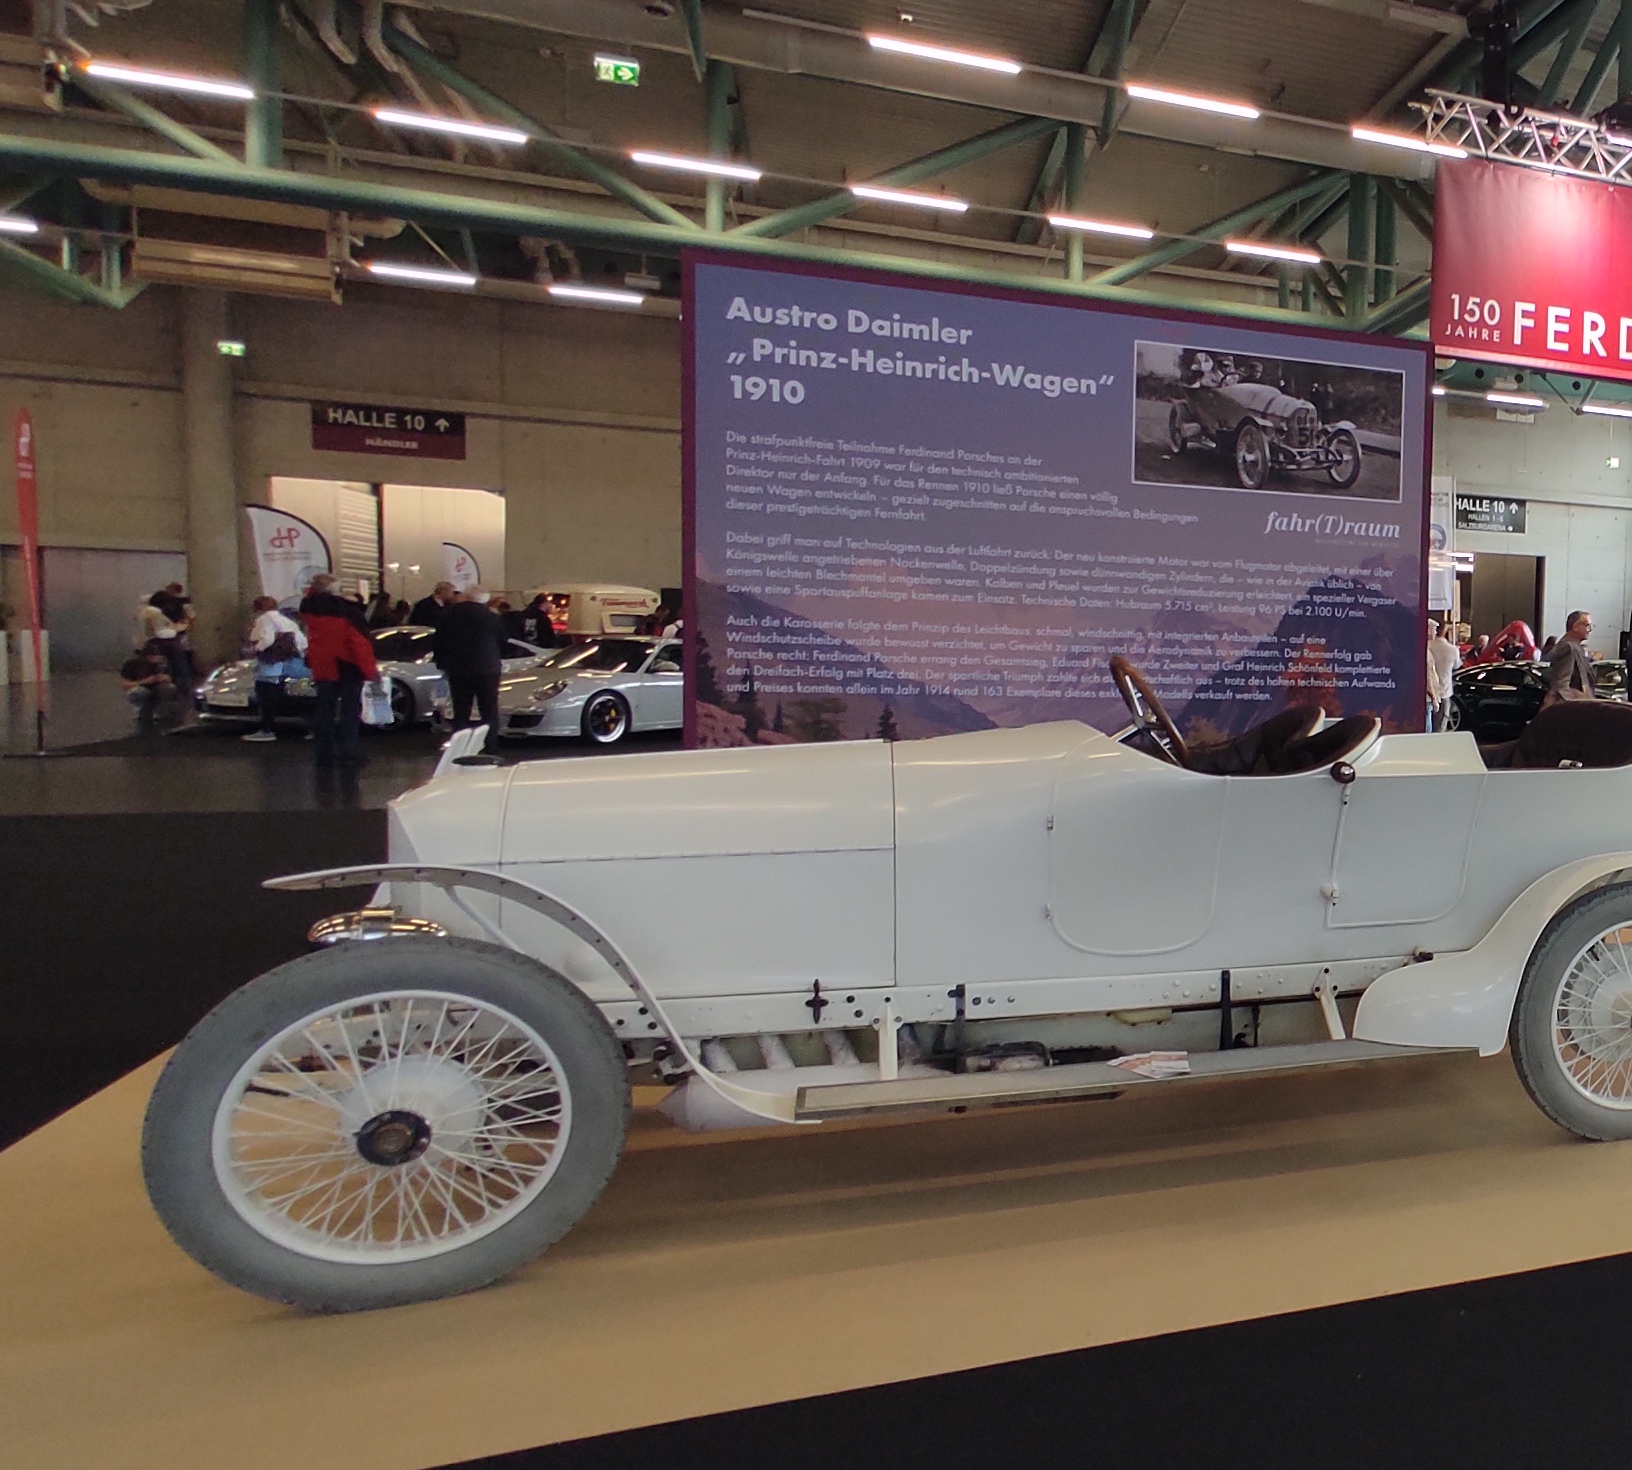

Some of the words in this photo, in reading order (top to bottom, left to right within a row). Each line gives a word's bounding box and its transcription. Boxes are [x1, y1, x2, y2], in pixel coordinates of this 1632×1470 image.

[1450, 293, 1501, 326] 150
[726, 297, 838, 331] Austro
[847, 309, 973, 345] Daimler
[1445, 324, 1501, 343] JAHRE
[730, 375, 805, 405] 1910
[328, 407, 398, 429] HALLE
[404, 415, 426, 431] 10
[726, 432, 747, 443] Die
[837, 440, 895, 454] Teilnahme
[899, 444, 954, 459] Ferdinand
[1024, 455, 1042, 466] der
[726, 448, 845, 467] Prinz-Heinrich-Fahrt
[850, 457, 881, 469] 1909
[909, 461, 924, 472] für
[927, 463, 948, 474] den
[726, 465, 774, 478] Direktor
[777, 471, 796, 480] nur
[800, 470, 820, 482] der
[873, 475, 891, 486] Für
[894, 476, 915, 488] das
[918, 478, 959, 491] Rennen
[963, 481, 990, 493] 1910
[726, 485, 763, 494] neuen
[767, 484, 812, 499] Wagen
[726, 498, 763, 511] dieser
[1455, 498, 1490, 512] HALLE
[1492, 501, 1505, 513] 10
[1263, 511, 1400, 538] fahr(T)raum
[726, 532, 763, 544] Dabei
[767, 534, 791, 547] griff
[795, 538, 820, 547] man
[823, 537, 842, 548] auf
[845, 538, 921, 554] Technologien
[923, 546, 944, 554] aus
[726, 615, 757, 626] Auch
[761, 616, 780, 627] die
[727, 648, 773, 660] Porsche
[813, 650, 871, 662] Ferdinand
[726, 665, 750, 676] den
[754, 666, 843, 681] Dreifach-Erfolg
[866, 668, 894, 679] Platz
[726, 682, 750, 692] und
[925, 685, 950, 696] 1914
